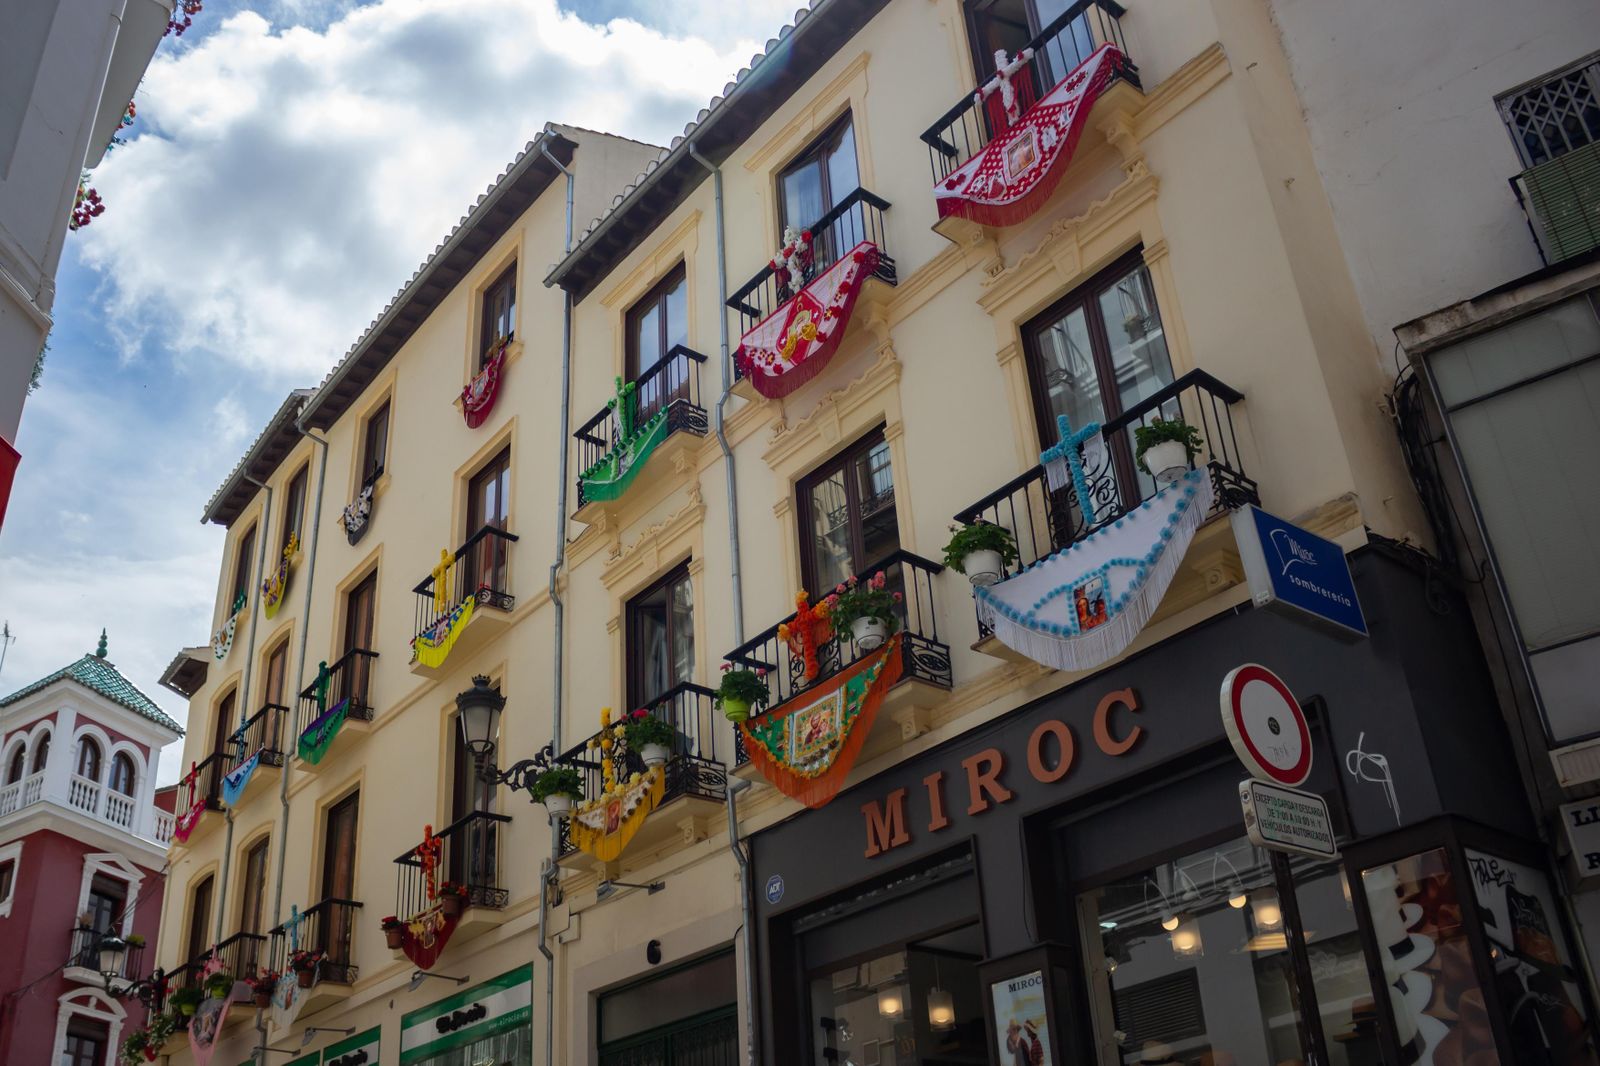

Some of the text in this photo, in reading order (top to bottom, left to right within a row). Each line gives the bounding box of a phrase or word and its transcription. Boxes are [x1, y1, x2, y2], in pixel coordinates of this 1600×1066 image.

[860, 687, 1144, 859] MIROC
[1267, 808, 1275, 818] DE
[1008, 976, 1042, 993] MIROC
